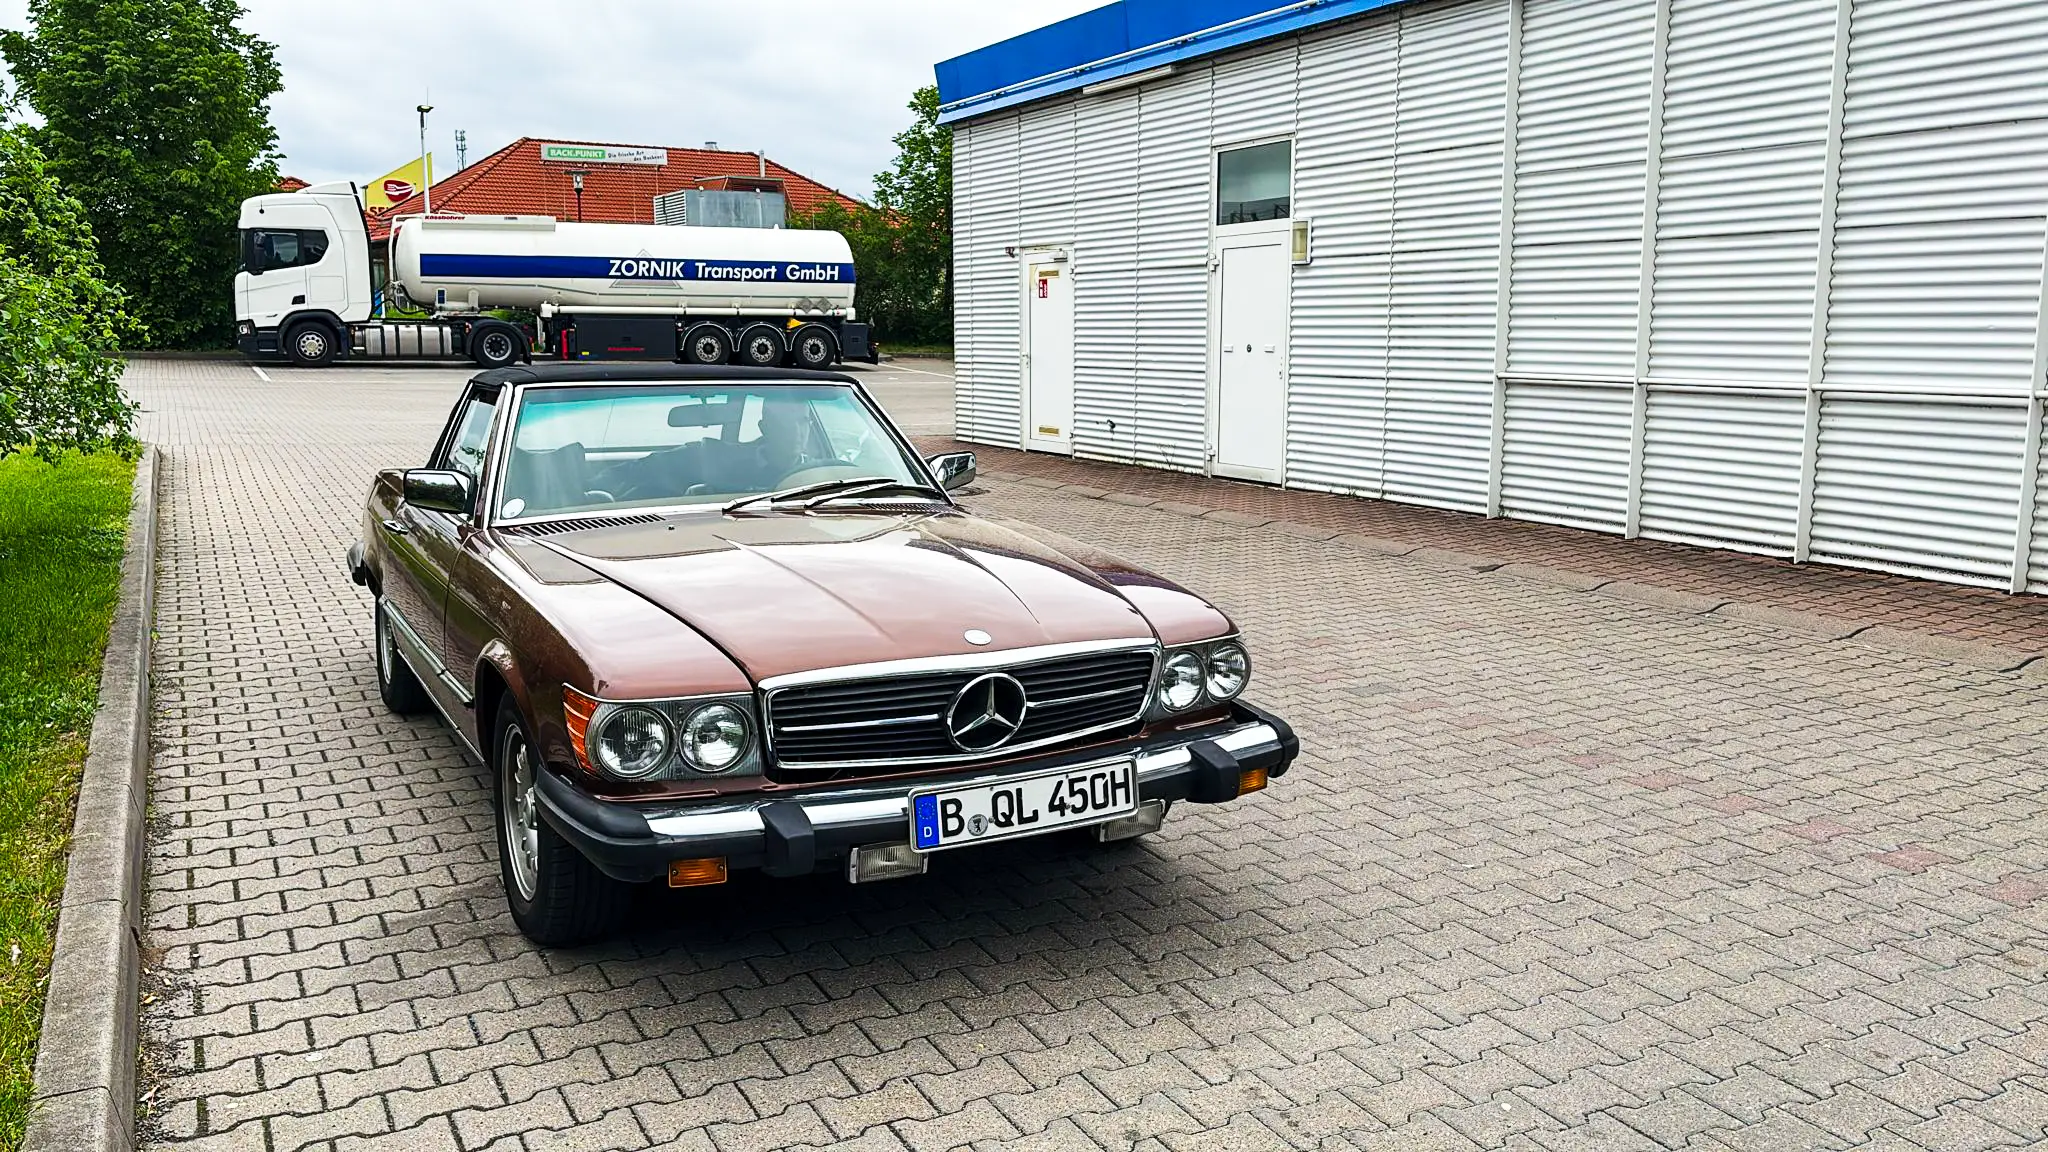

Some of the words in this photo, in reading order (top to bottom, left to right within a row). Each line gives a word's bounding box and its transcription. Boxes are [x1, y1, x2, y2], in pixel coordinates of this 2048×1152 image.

[608, 259, 685, 277] ZORNIK
[695, 262, 777, 281] Transport
[786, 264, 839, 281] GmbH
[940, 798, 965, 838] B
[991, 788, 1039, 828] QL
[1048, 767, 1131, 817] 450H
[923, 826, 932, 838] D
